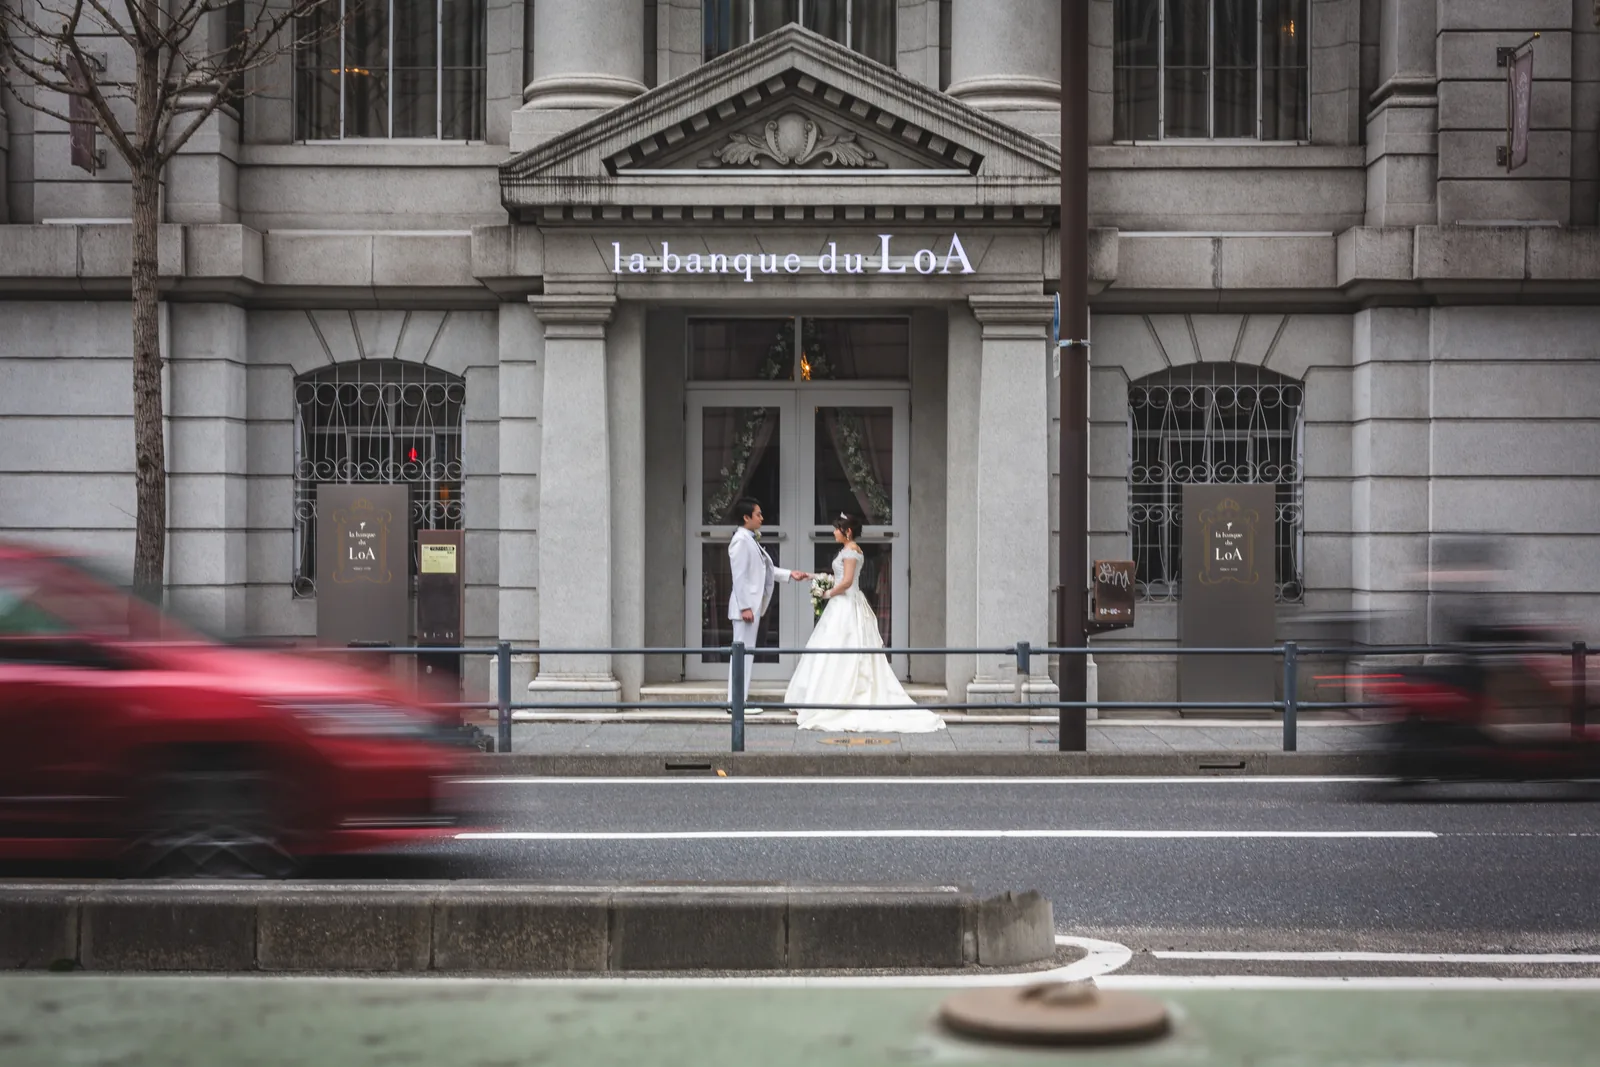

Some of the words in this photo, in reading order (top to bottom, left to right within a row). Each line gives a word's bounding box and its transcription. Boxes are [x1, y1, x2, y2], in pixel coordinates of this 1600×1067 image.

[611, 241, 647, 274] la
[661, 241, 801, 282] banque
[818, 242, 867, 274] du
[877, 232, 976, 274] LoA
[348, 530, 355, 538] la
[349, 546, 376, 560] LoA
[1215, 547, 1243, 561] LoA
